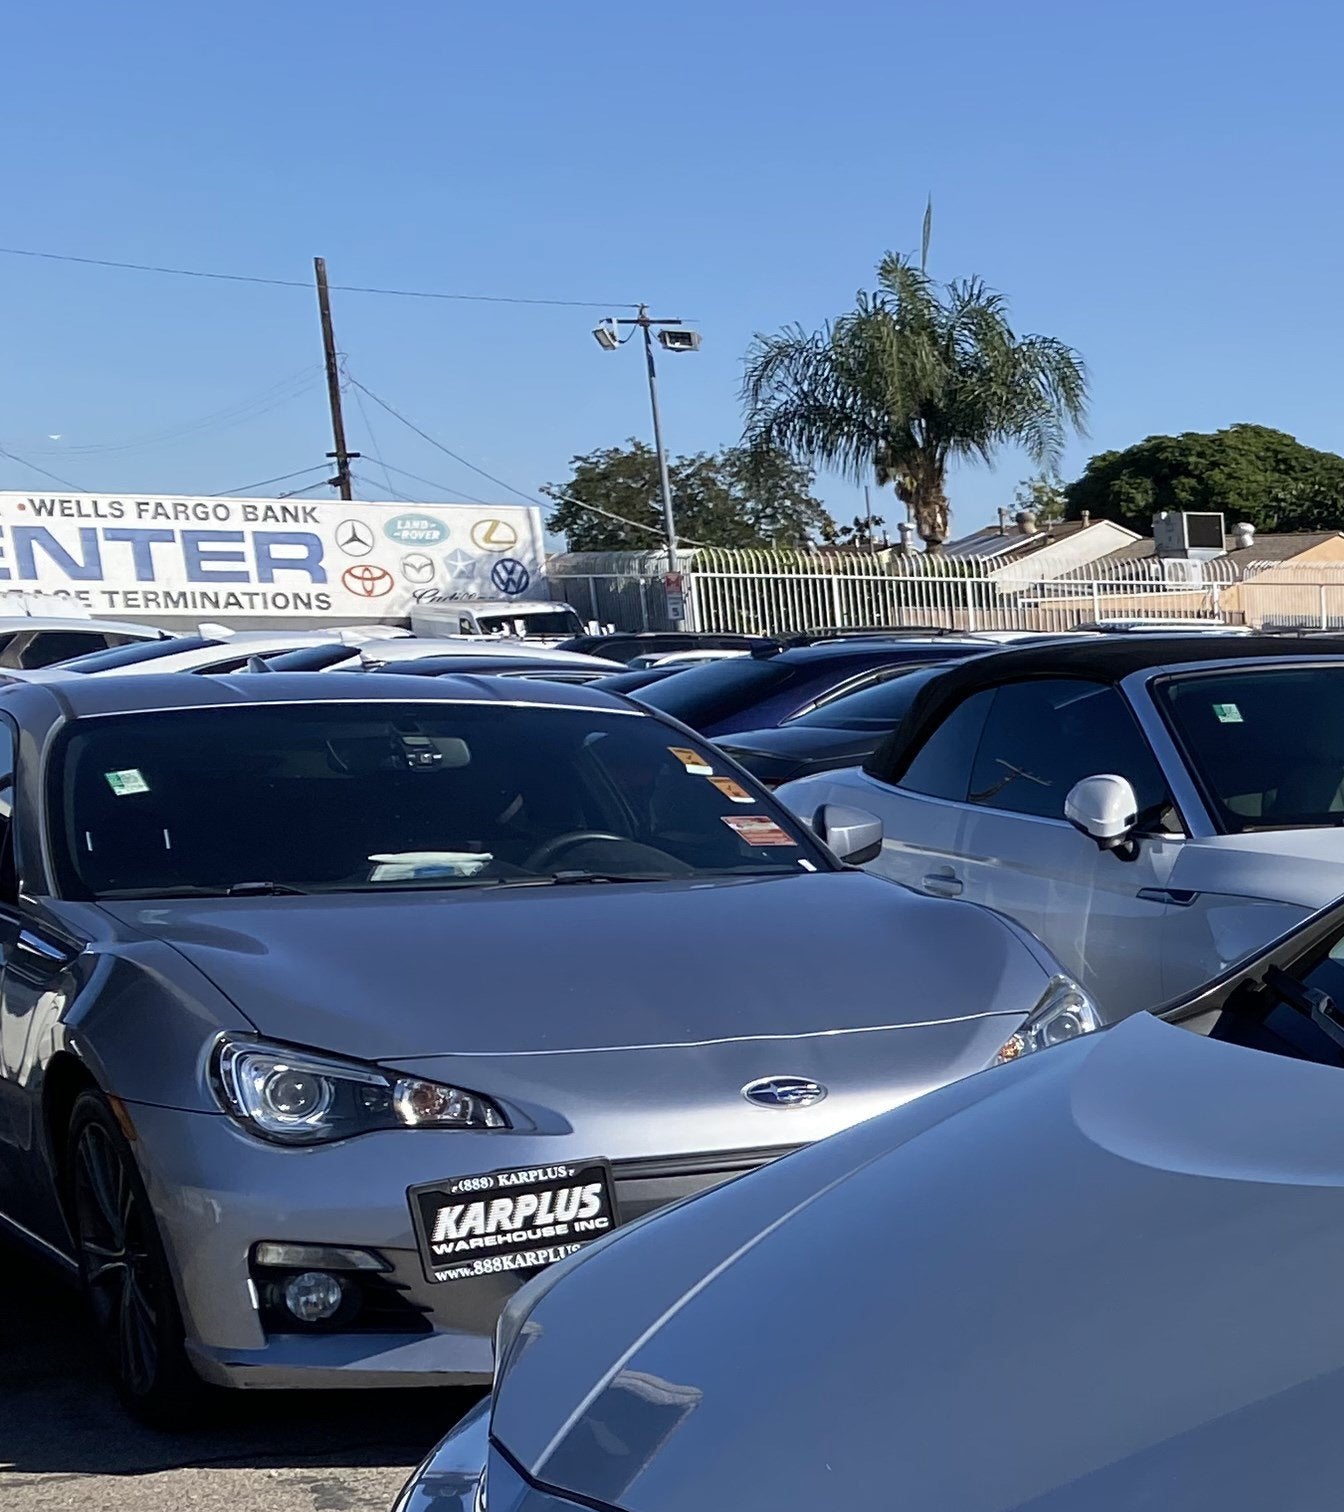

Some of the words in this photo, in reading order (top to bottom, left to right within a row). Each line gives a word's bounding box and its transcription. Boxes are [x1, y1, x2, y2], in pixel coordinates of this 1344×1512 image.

[27, 497, 126, 519] WELLS
[135, 500, 231, 522] FARGO
[241, 504, 320, 524] BANK
[0, 525, 328, 584] NTER
[100, 590, 332, 611] TERMINATIONS
[458, 1177, 494, 1192] (888)
[498, 1165, 568, 1187] KARPLUS
[432, 1183, 603, 1242] KARPLUS
[432, 1223, 569, 1256] WAREHOUSE
[574, 1217, 609, 1232] INC
